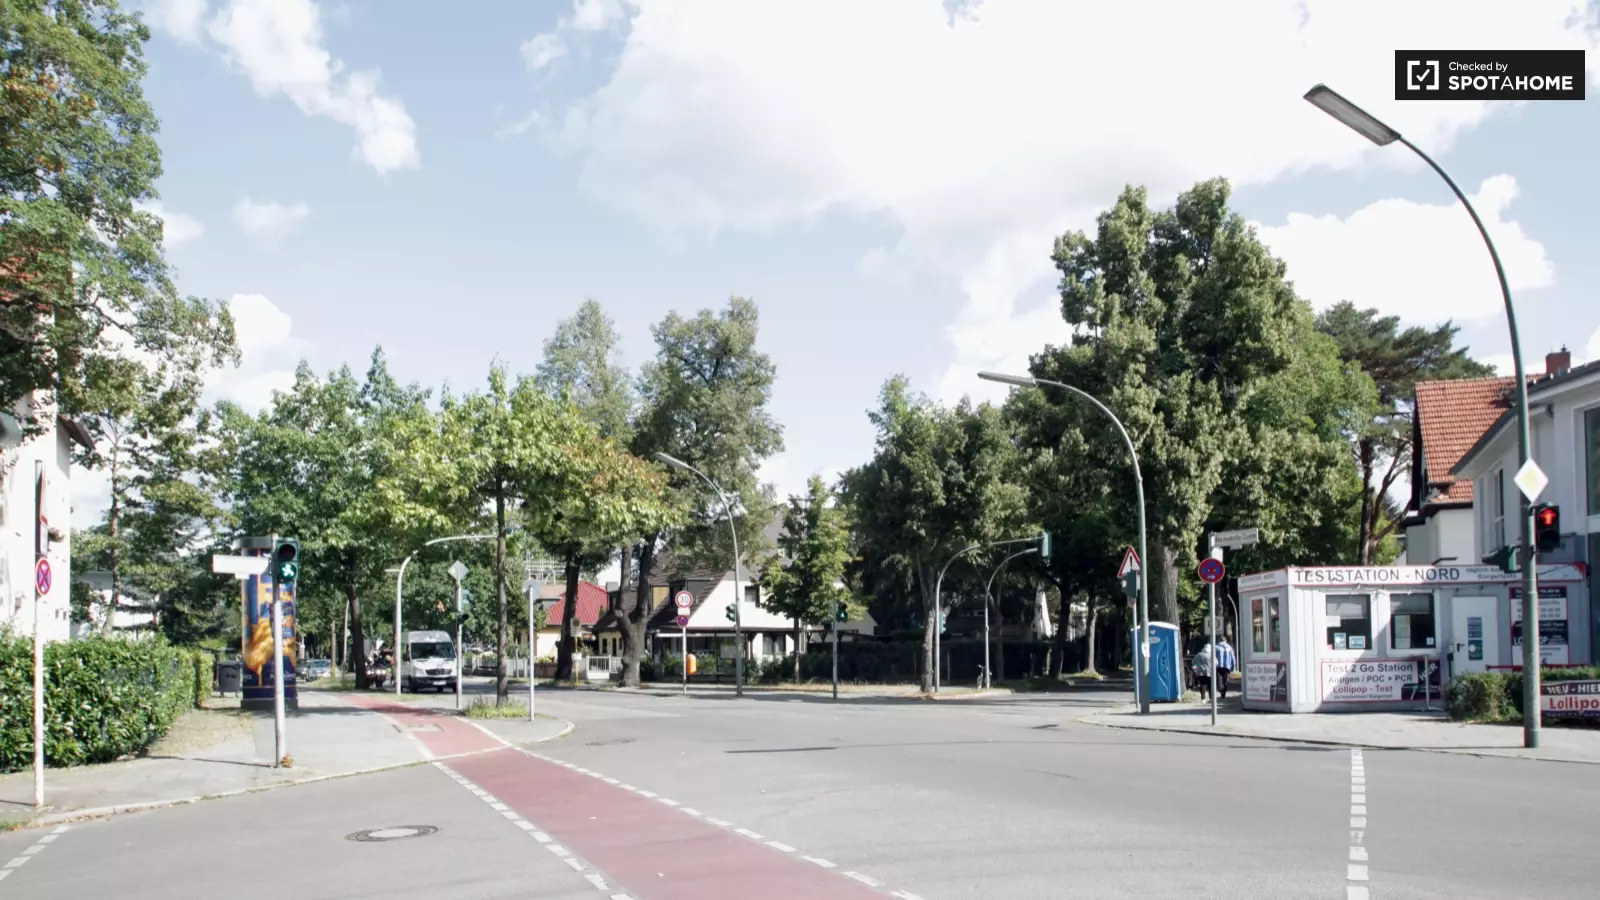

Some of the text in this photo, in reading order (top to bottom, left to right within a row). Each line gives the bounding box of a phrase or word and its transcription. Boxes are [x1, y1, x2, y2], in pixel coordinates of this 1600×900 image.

[1295, 569, 1399, 582] TESTSTATION
[1415, 568, 1460, 580] NORD
[1328, 663, 1413, 672] Test 2 Go Station
[1333, 685, 1367, 694] Lollipop
[1375, 685, 1393, 693] Test
